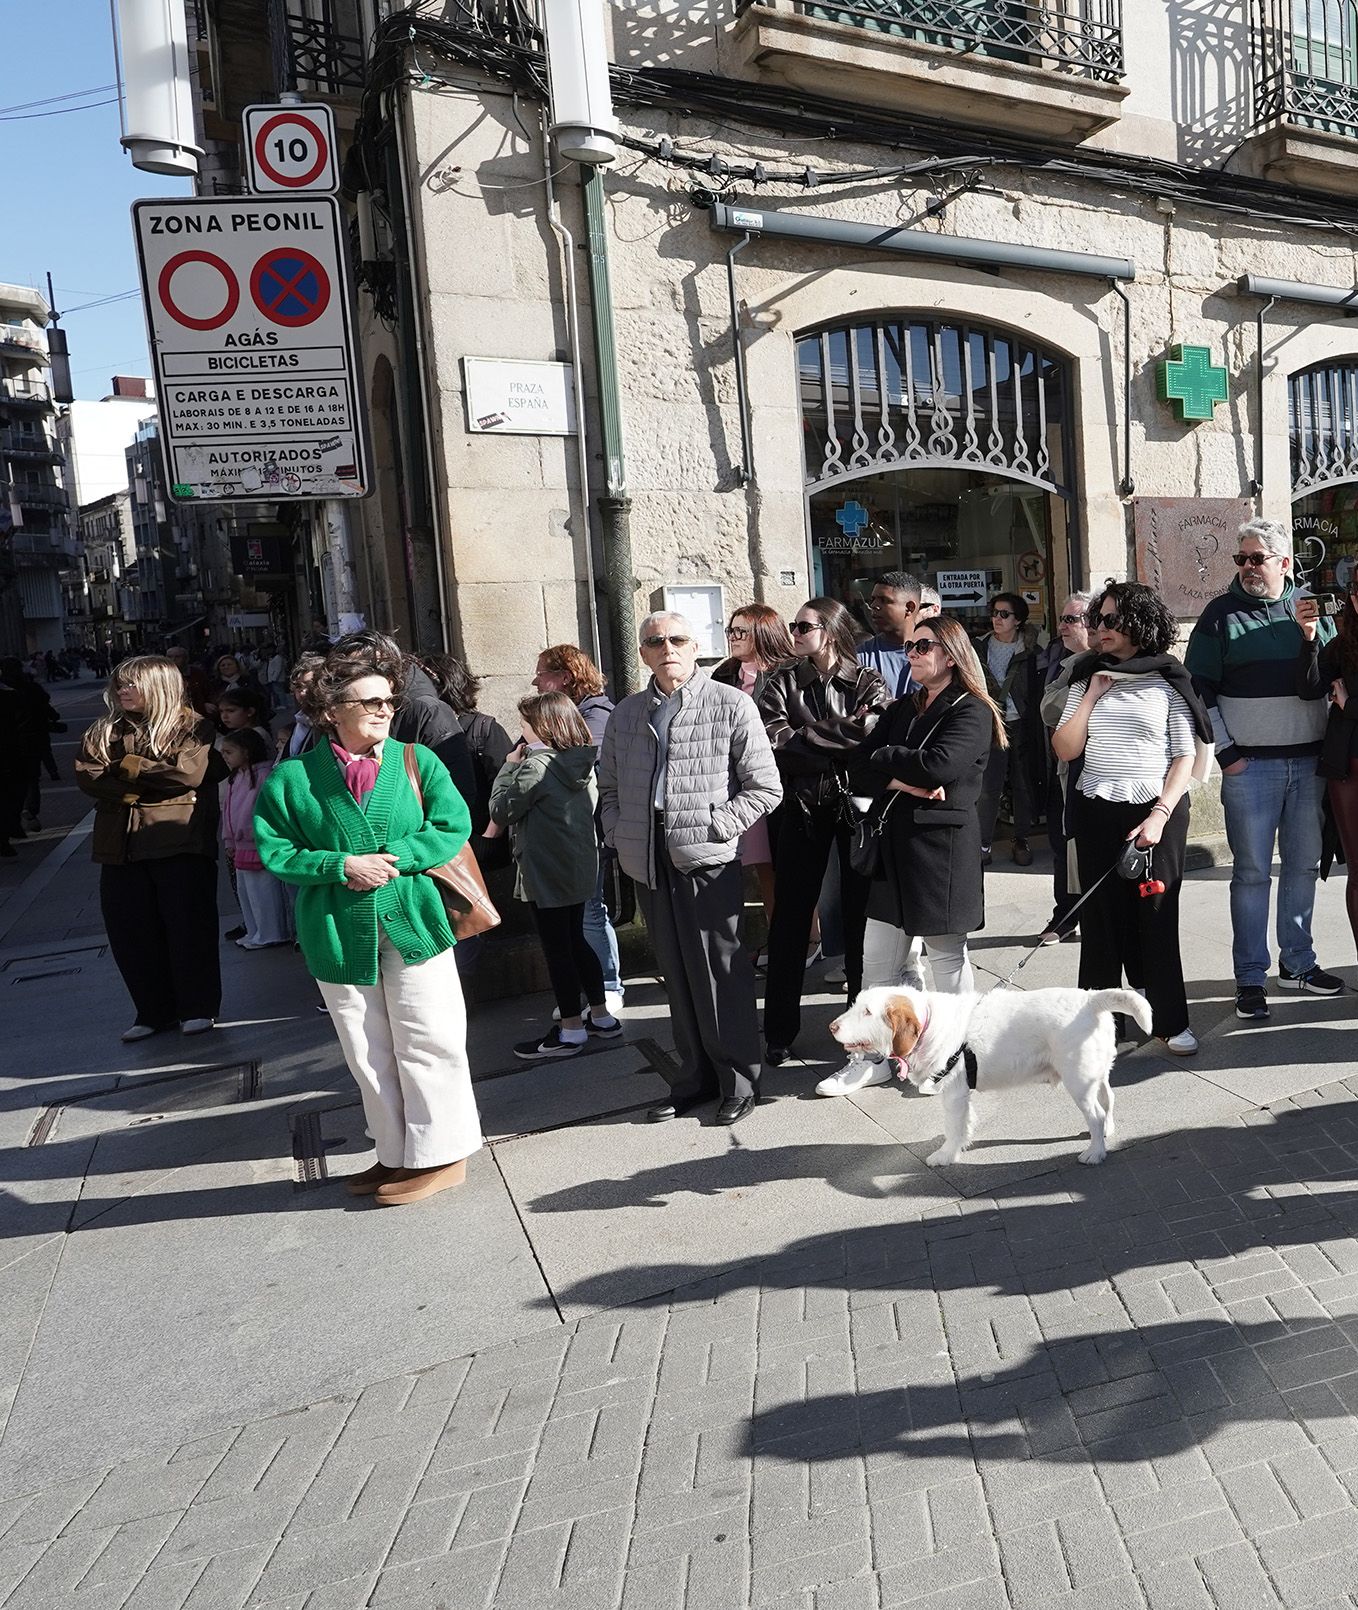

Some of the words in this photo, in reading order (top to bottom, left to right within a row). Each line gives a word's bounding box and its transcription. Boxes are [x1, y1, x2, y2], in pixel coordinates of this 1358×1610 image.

[273, 138, 308, 162] 10
[150, 214, 223, 234] ZONA
[231, 212, 324, 232] PEONIL
[224, 328, 279, 347] AGÁS
[208, 354, 299, 370] BICICLETAS
[175, 390, 231, 403] CARGA
[236, 389, 246, 401] E
[251, 386, 339, 400] DESCARGA
[509, 382, 545, 394] PRAZA
[508, 397, 549, 410] ESPAÑA
[173, 408, 224, 419] LABORAIS
[228, 408, 241, 416] DE
[245, 407, 251, 416] 8
[255, 407, 262, 415] A
[265, 406, 275, 415] 12
[278, 406, 284, 414] E
[288, 405, 301, 414] DE
[304, 405, 314, 413] 16
[318, 405, 325, 413] A
[328, 404, 345, 412] 18H
[207, 421, 220, 430] 30
[223, 420, 248, 430] MIN.
[250, 420, 256, 428] E
[260, 419, 276, 430] 3,5
[280, 416, 345, 427] TONELADAS
[209, 449, 322, 464] AUTORIZADOS
[281, 465, 323, 474] INUTOS
[1178, 515, 1227, 531] FARMACIA
[818, 537, 884, 548] FARMAZUL
[1179, 584, 1203, 600] PLAZA
